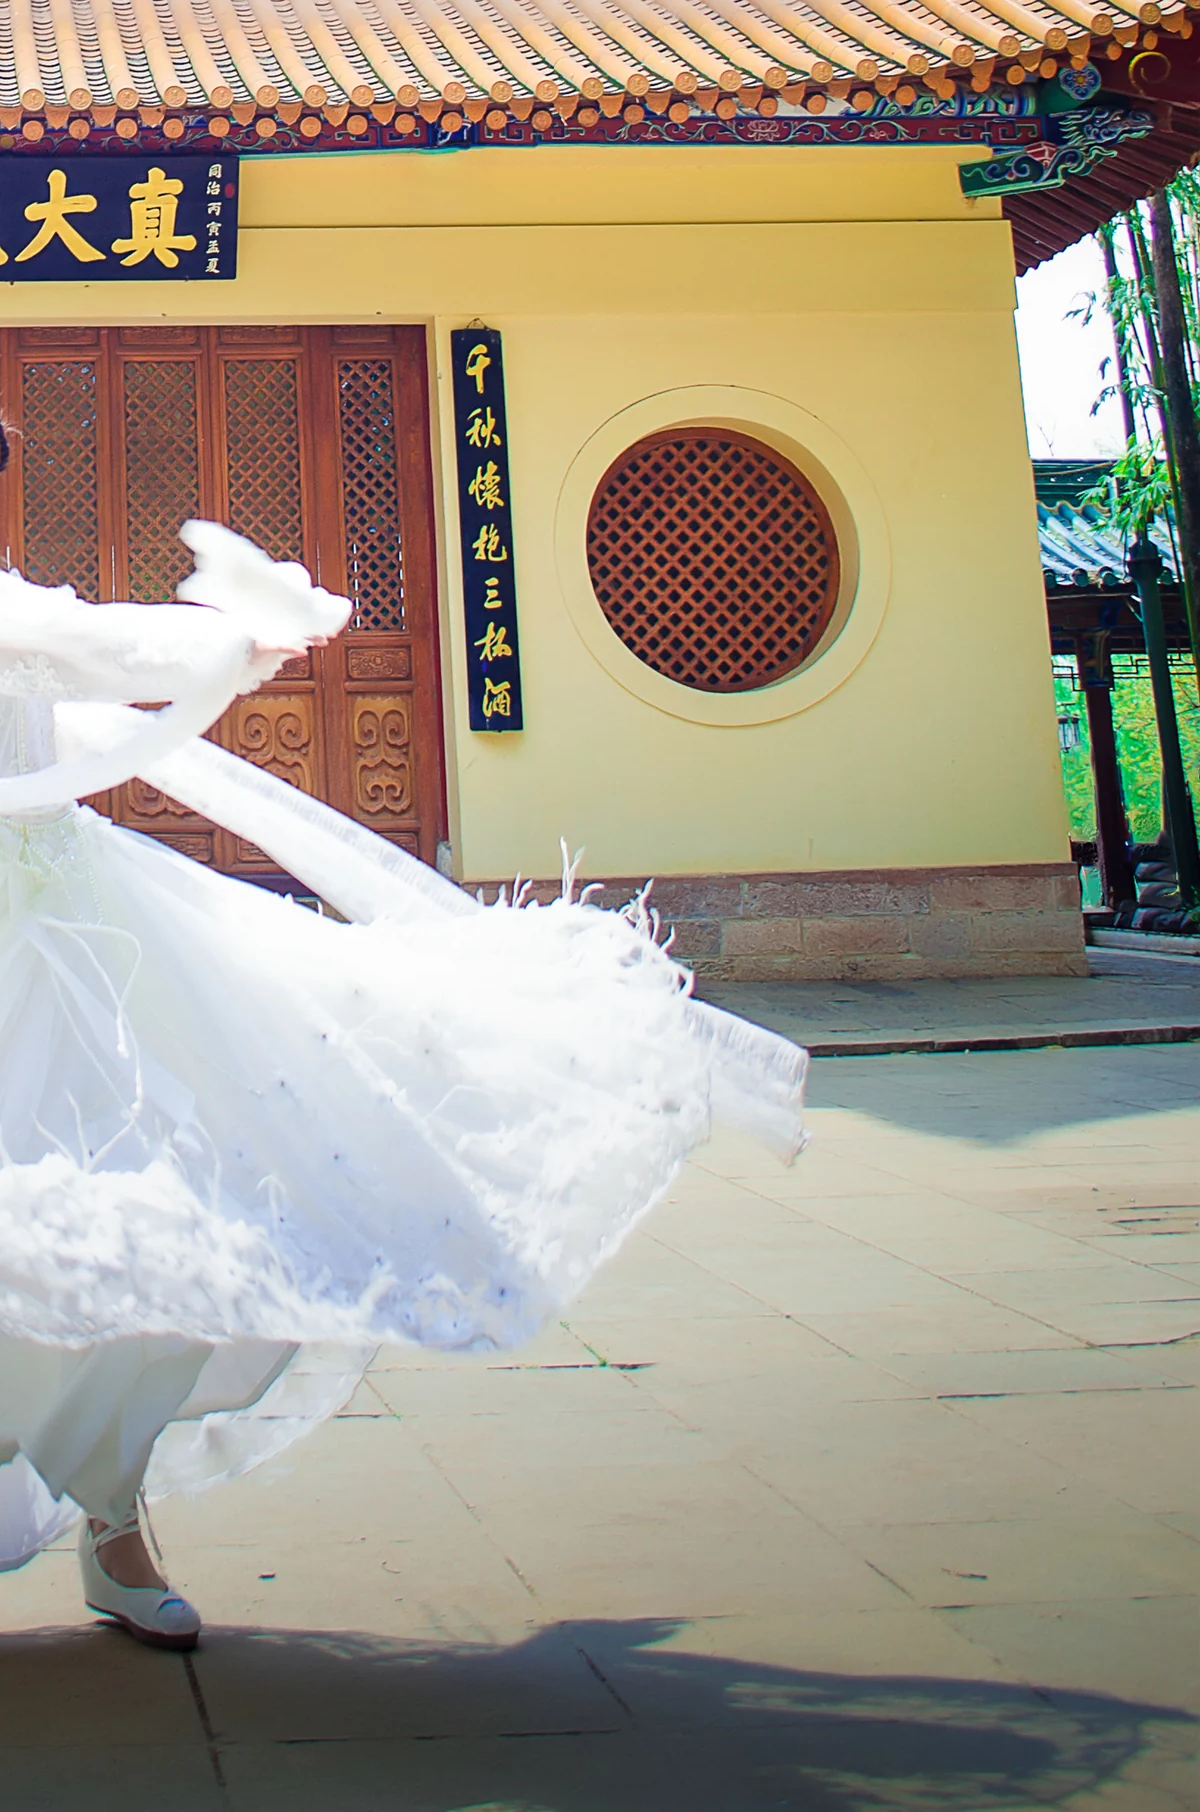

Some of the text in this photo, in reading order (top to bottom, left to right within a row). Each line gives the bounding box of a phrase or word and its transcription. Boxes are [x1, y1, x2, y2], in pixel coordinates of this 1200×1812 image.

[205, 163, 222, 274] 同治丙寅孟夏
[465, 343, 513, 717] 千秋懷抱三杯酒
